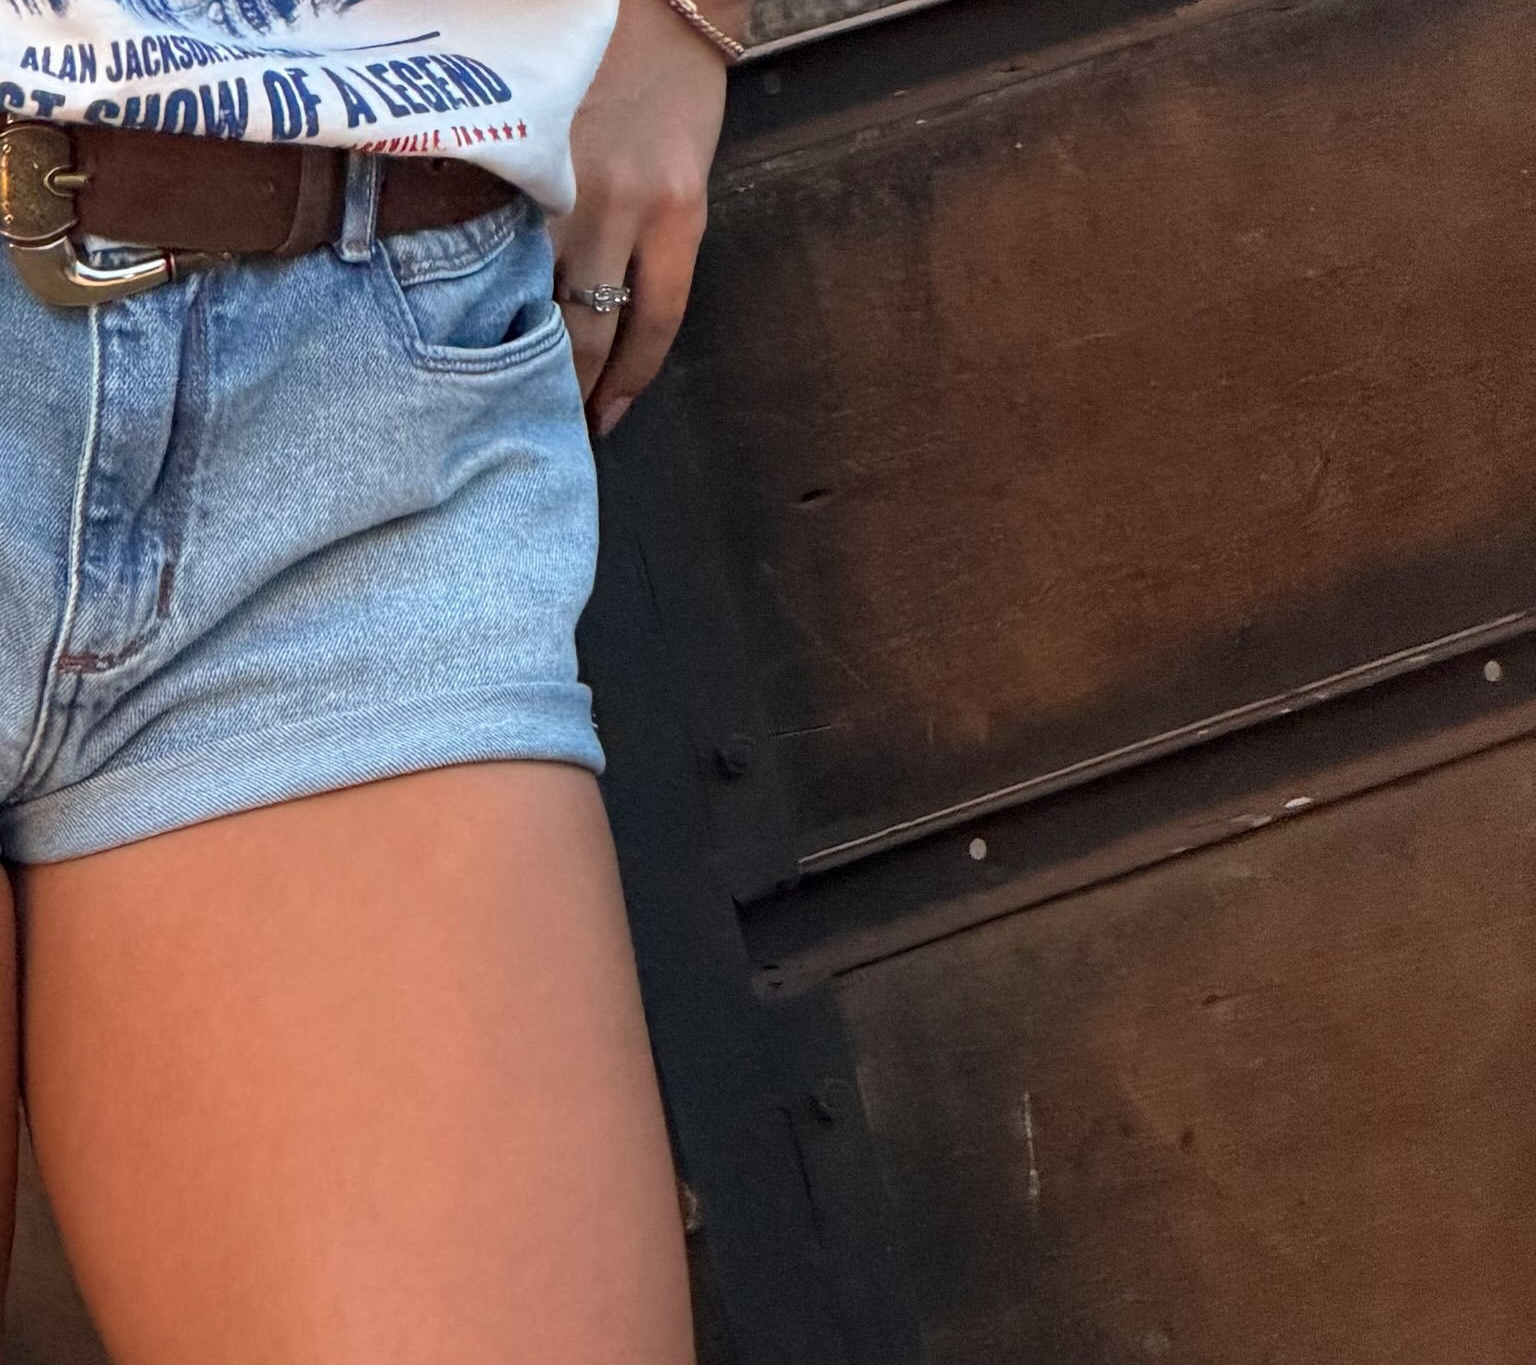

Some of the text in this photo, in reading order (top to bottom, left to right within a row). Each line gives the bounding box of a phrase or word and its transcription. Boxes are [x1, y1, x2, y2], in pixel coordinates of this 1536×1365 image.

[20, 43, 97, 83] ALAN
[346, 54, 512, 118] LEGEND
[263, 68, 323, 141] OF
[321, 67, 377, 128] A
